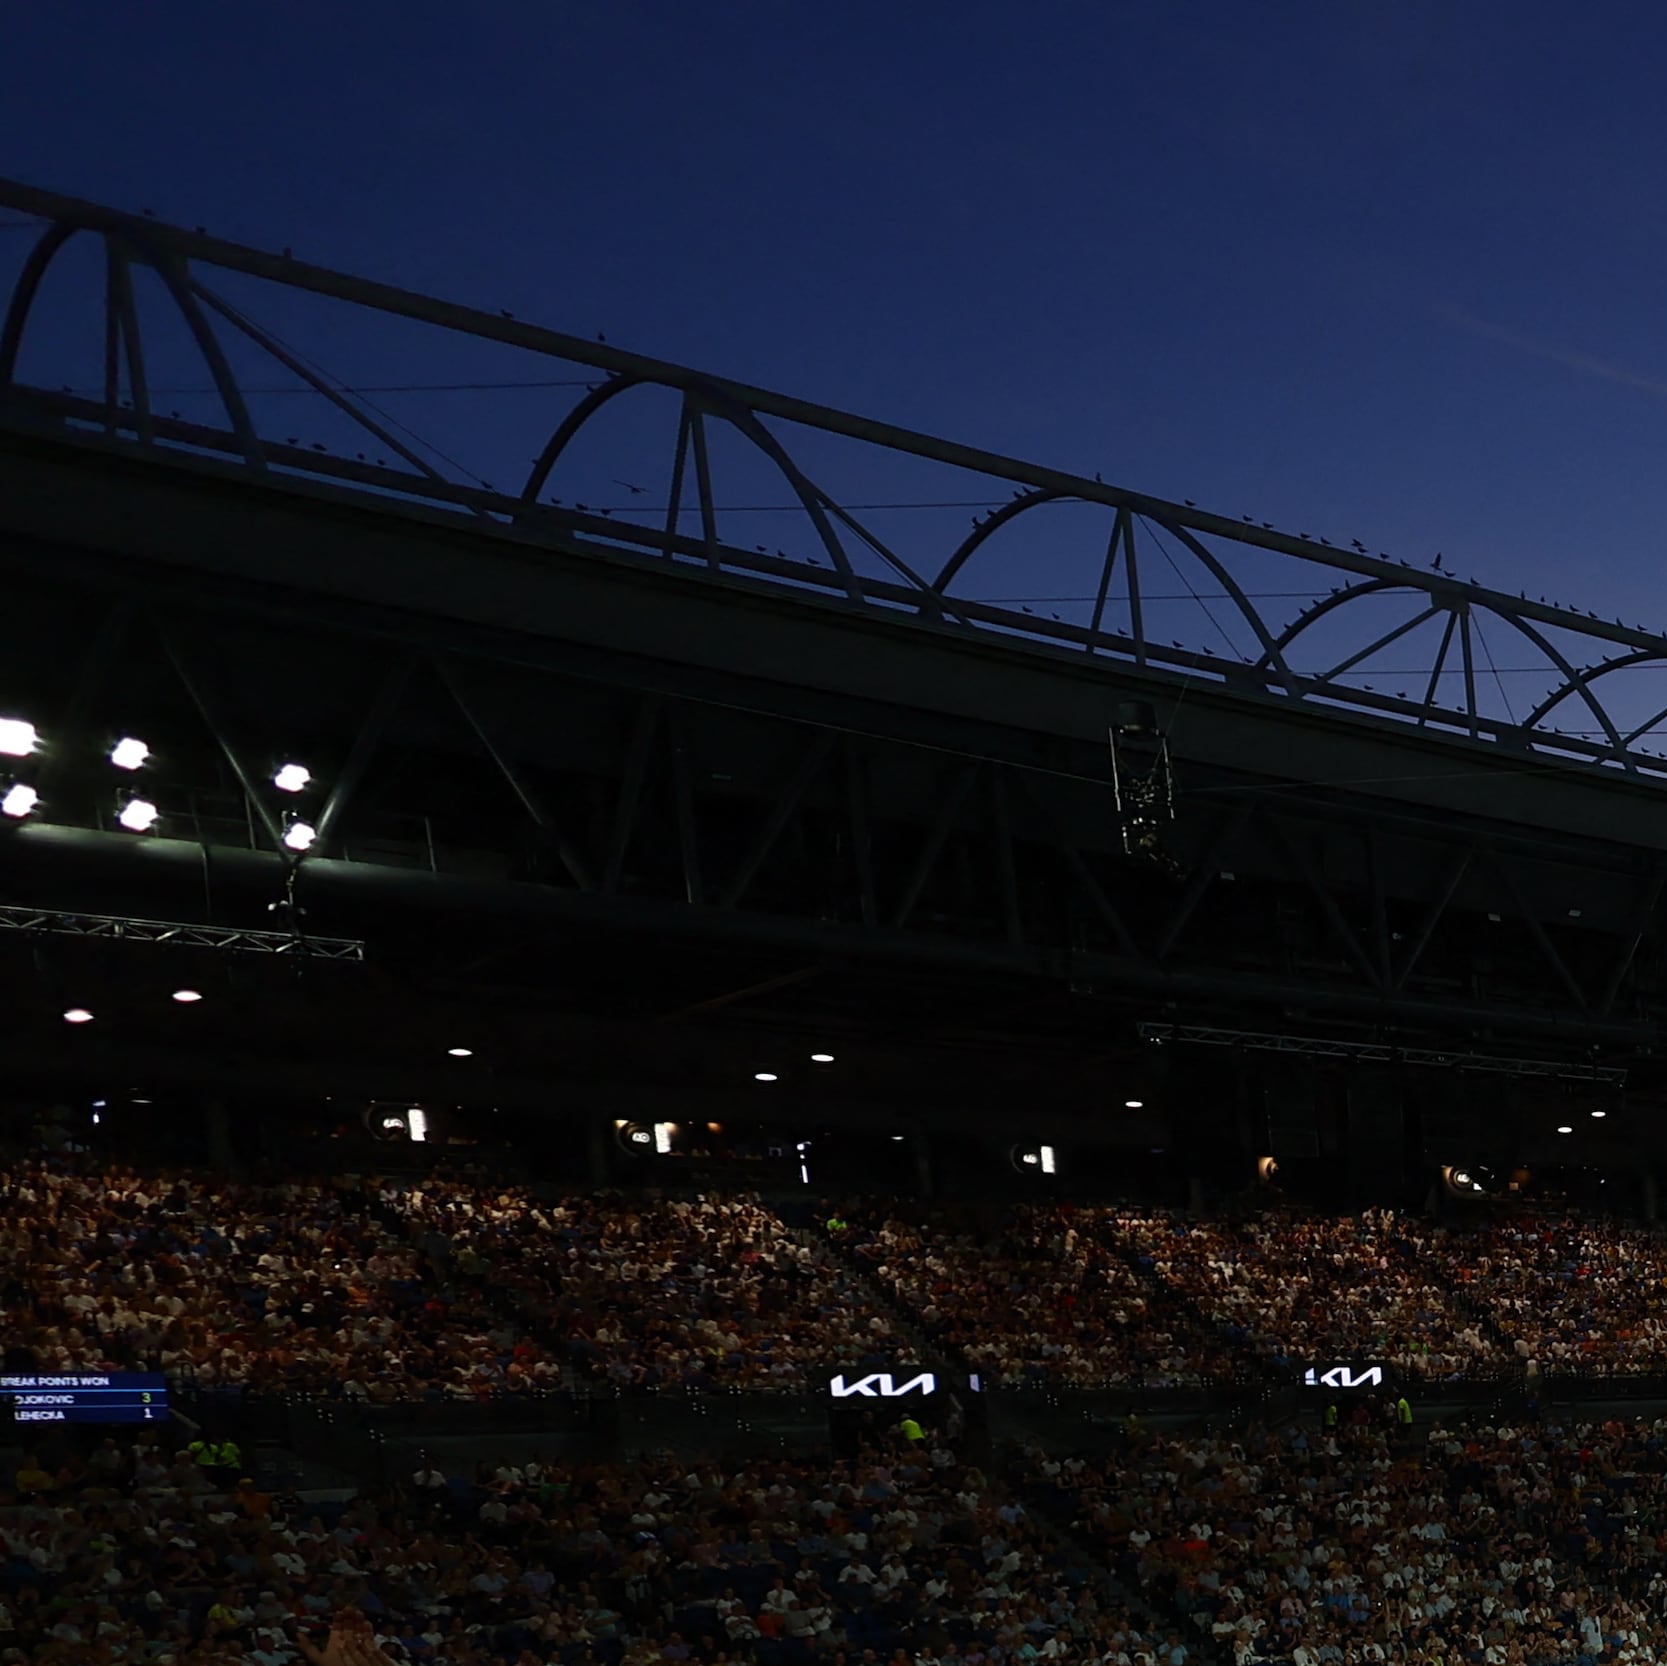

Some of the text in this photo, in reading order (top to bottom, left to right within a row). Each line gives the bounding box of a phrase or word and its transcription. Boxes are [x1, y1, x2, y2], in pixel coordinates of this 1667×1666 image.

[38, 1376, 79, 1387] POINTS
[80, 1376, 110, 1386] WON
[831, 1373, 934, 1396] KIA
[141, 1392, 151, 1404] 3
[143, 1407, 153, 1418] 1
